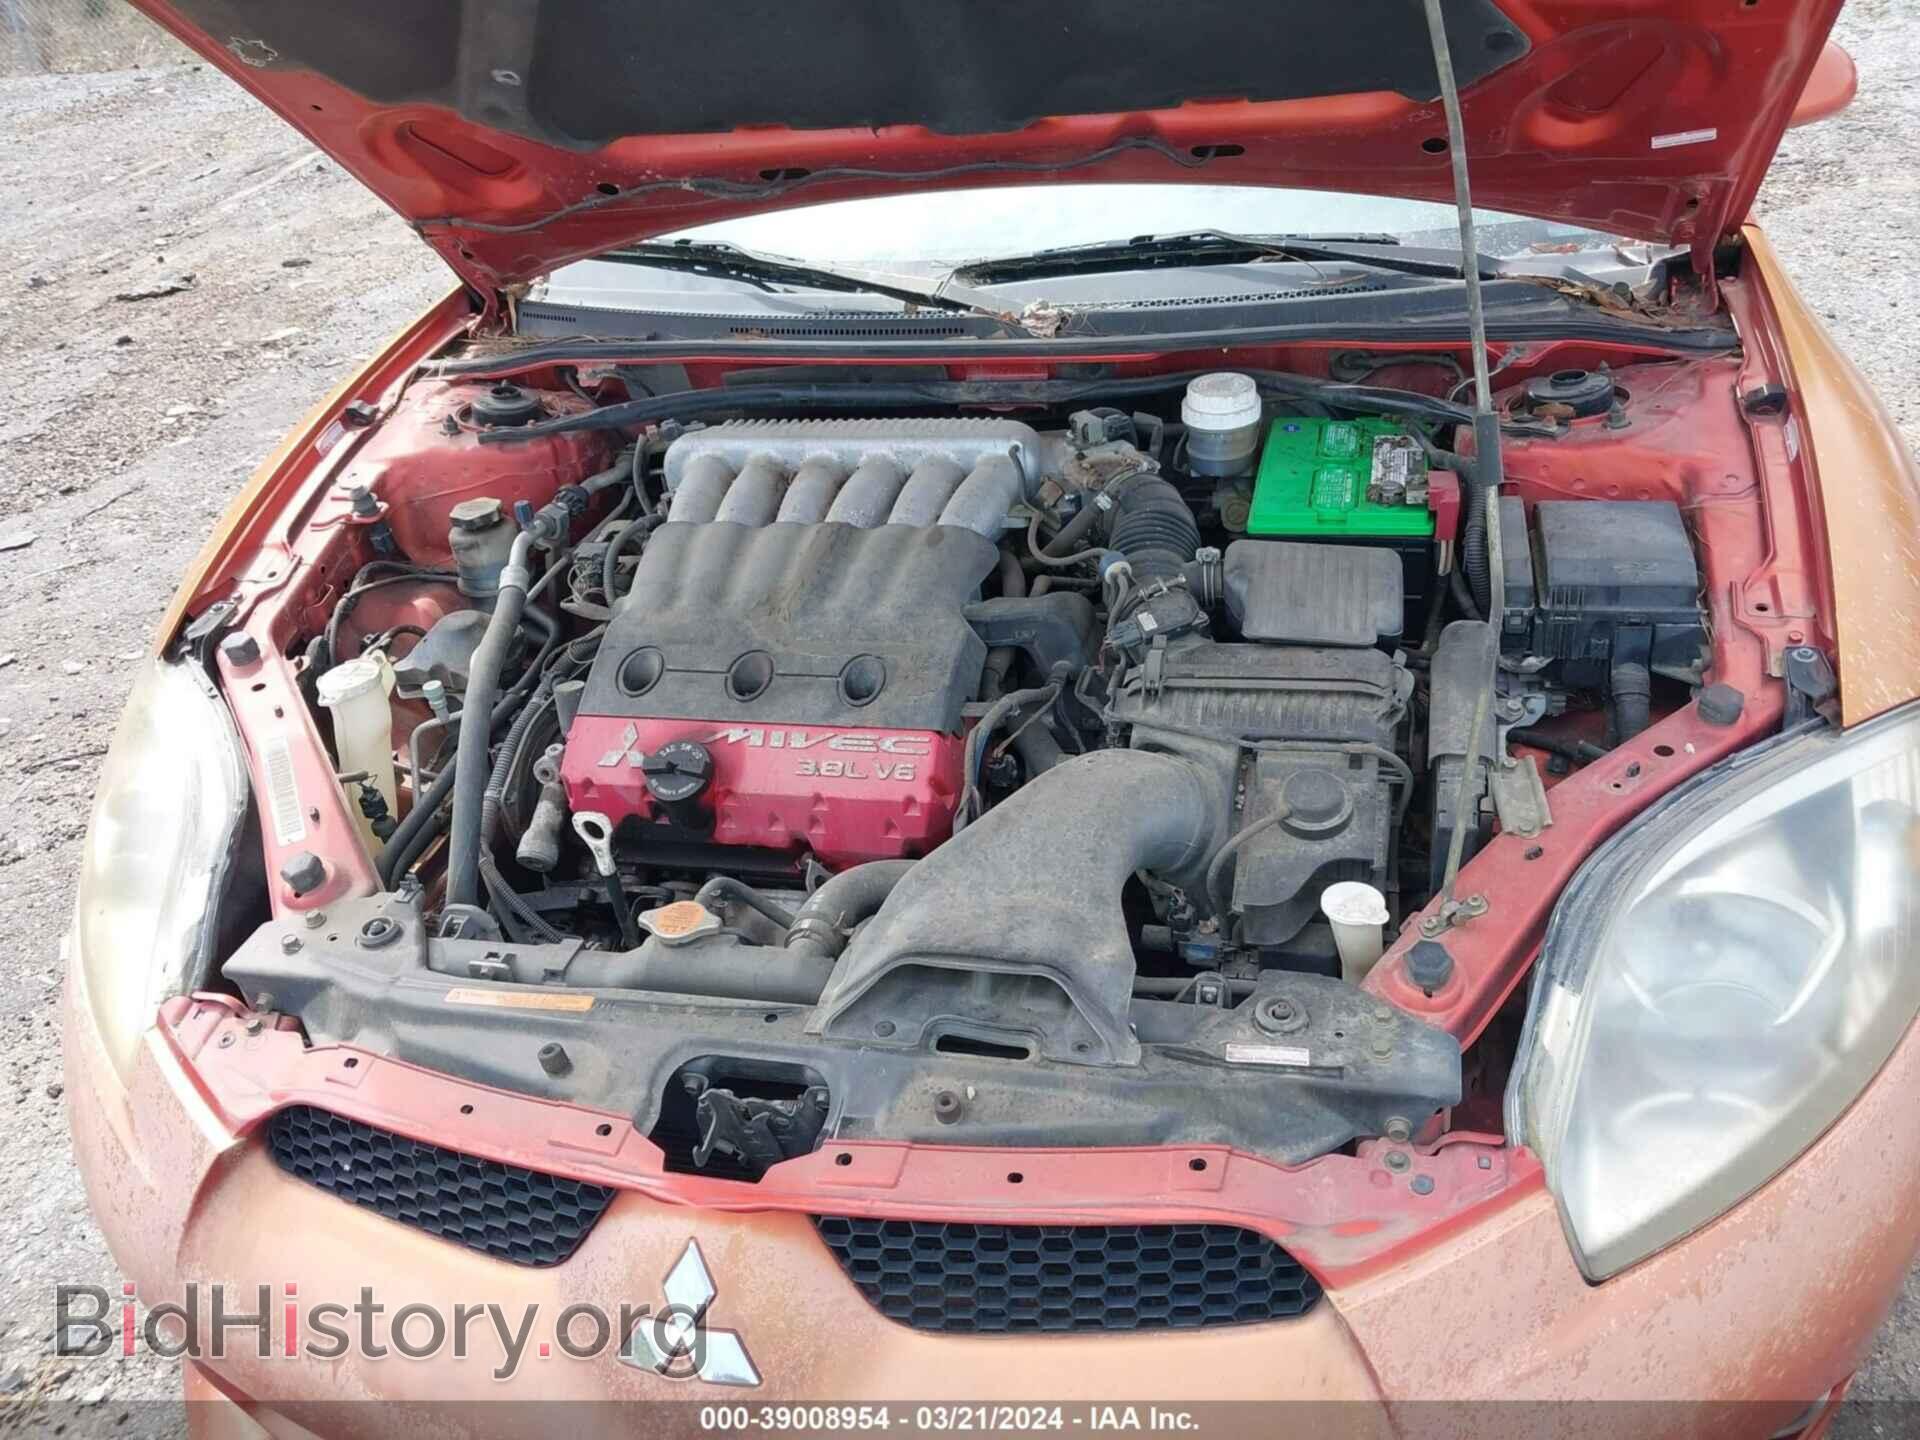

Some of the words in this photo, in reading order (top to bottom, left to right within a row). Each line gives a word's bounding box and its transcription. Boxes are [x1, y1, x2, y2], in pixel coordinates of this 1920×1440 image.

[703, 728, 931, 755] MIVEC
[795, 758, 868, 779] 3.8L
[874, 761, 916, 781] V6
